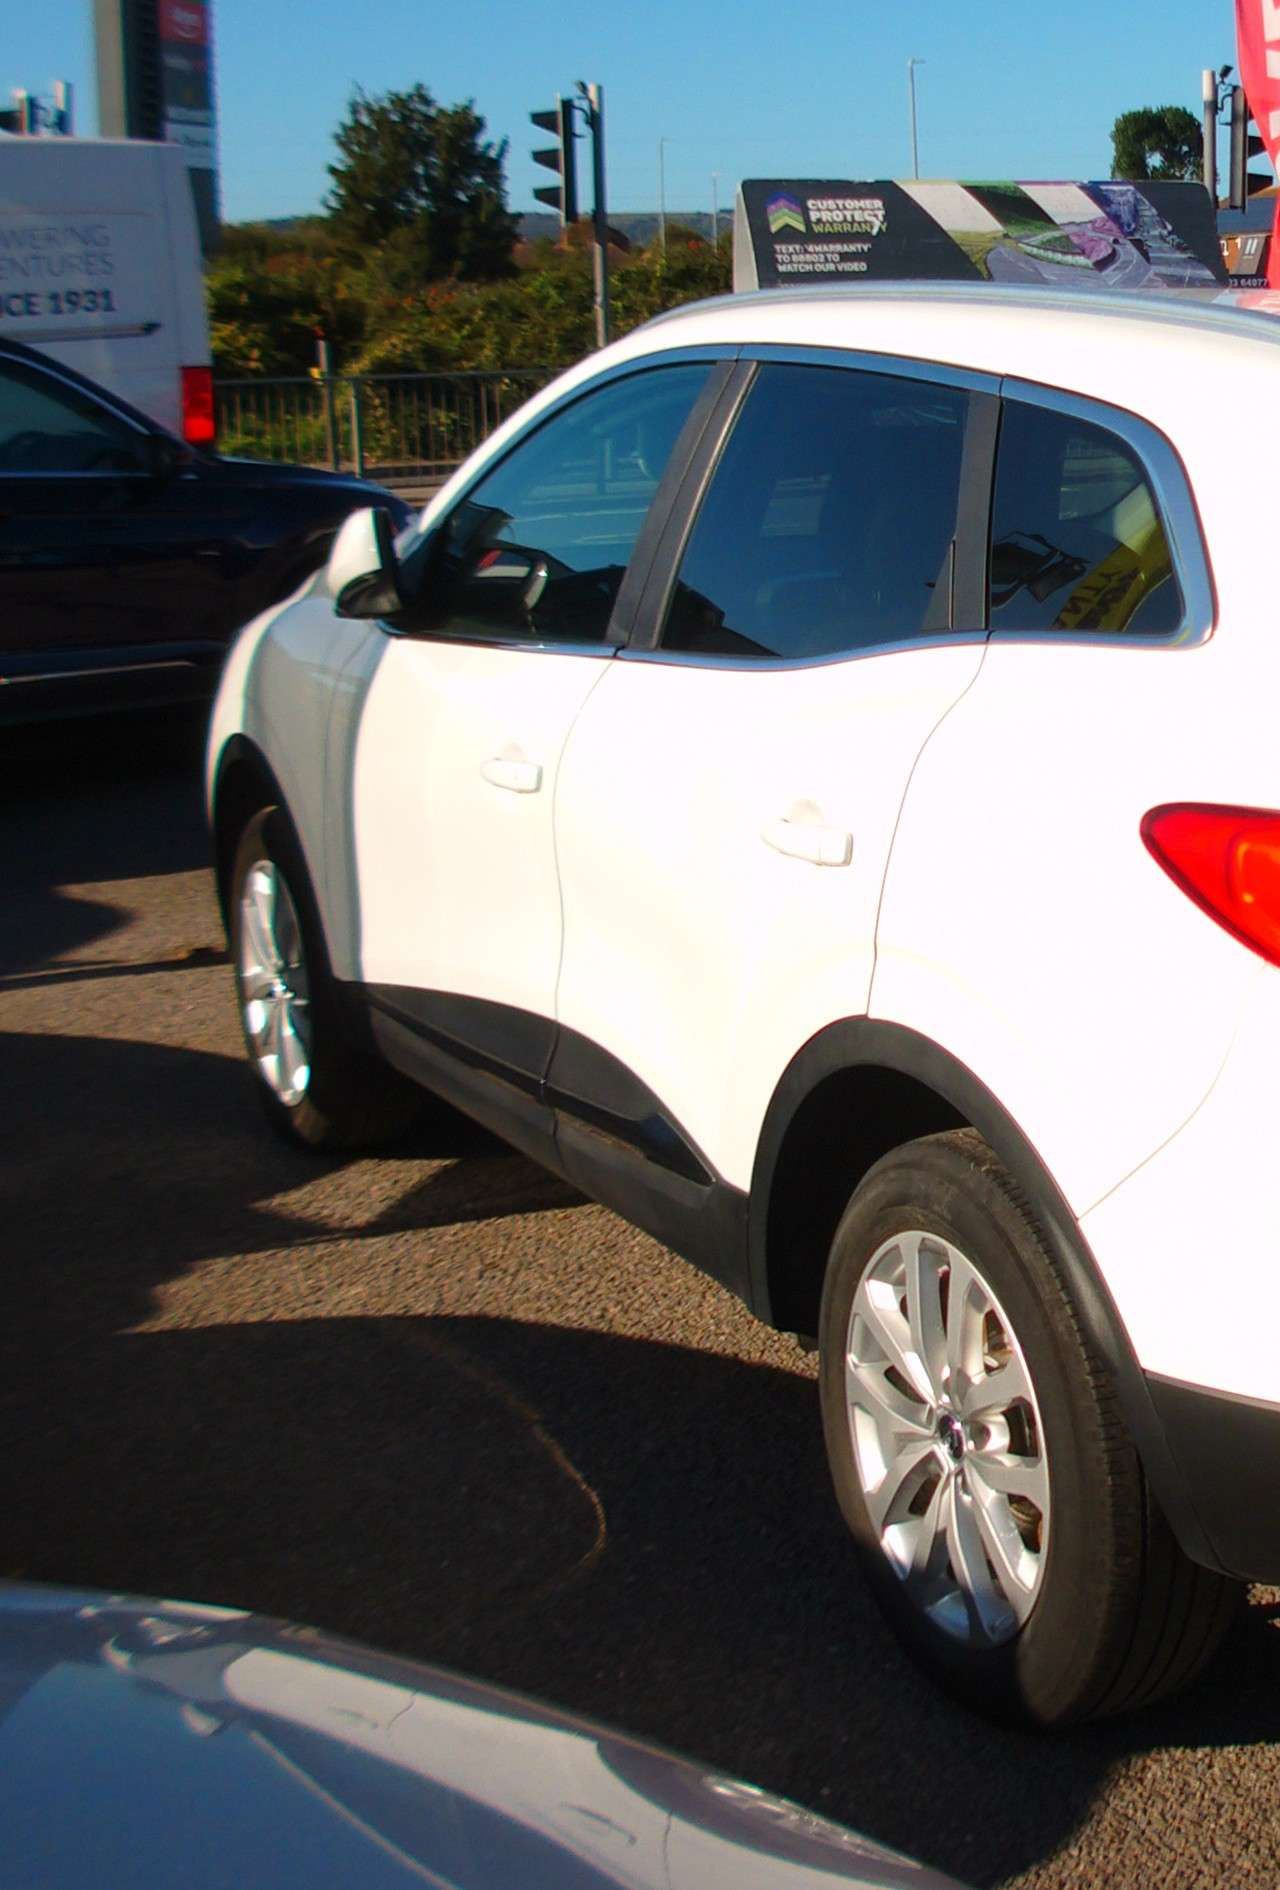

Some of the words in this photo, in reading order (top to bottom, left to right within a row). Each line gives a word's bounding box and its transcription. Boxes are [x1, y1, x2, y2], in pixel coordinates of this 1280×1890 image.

[806, 198, 884, 211] CUSTOMER
[808, 209, 887, 223] PROTECT
[777, 263, 813, 273] WATCH
[815, 263, 837, 272] OUR
[838, 262, 868, 272] VIDEO
[0, 292, 42, 317] CE
[48, 289, 116, 315] 1931
